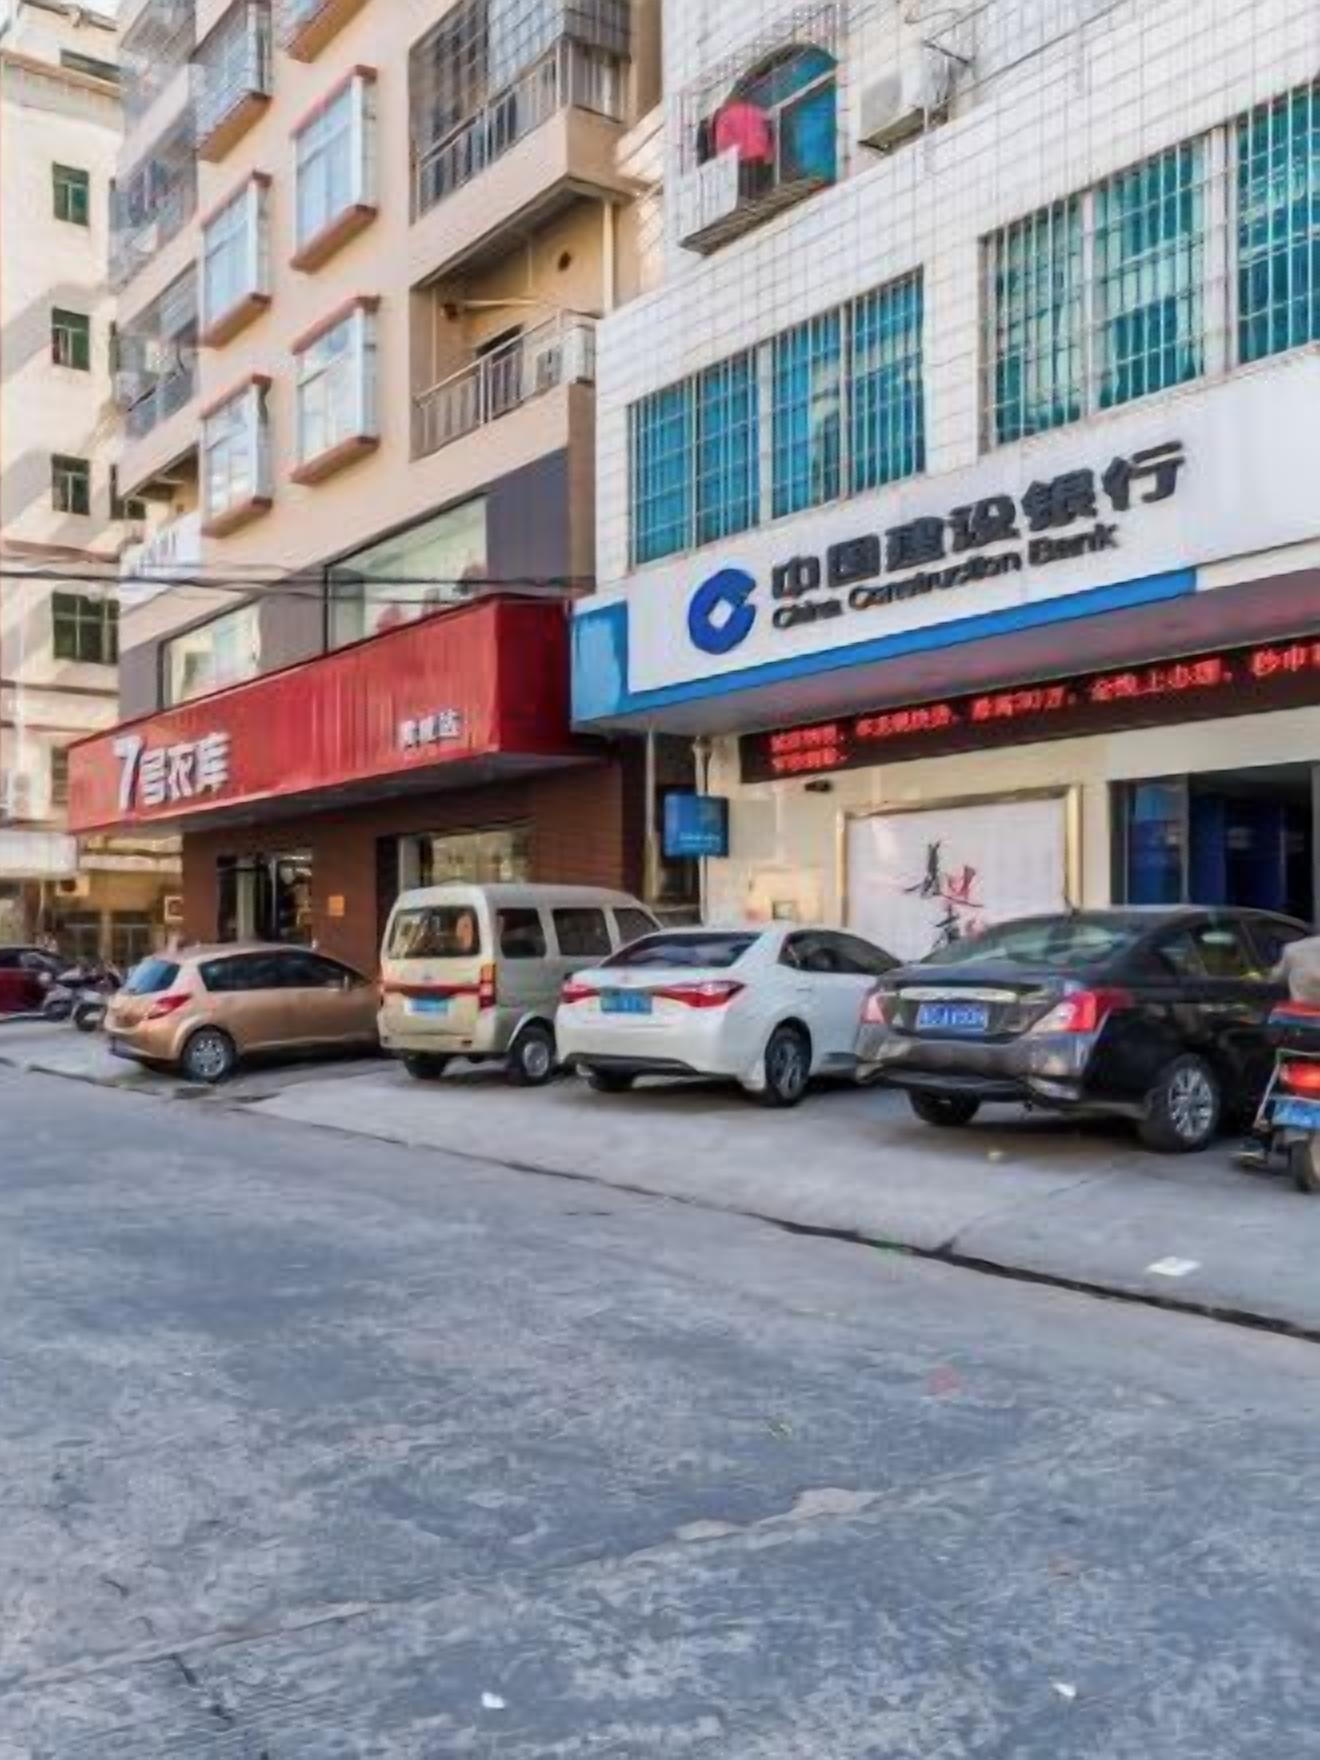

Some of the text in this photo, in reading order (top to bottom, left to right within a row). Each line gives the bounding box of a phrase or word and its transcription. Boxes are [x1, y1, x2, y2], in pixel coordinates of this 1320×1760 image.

[771, 440, 1186, 600] 中国建设银行
[772, 522, 1120, 629] China Construction Bank
